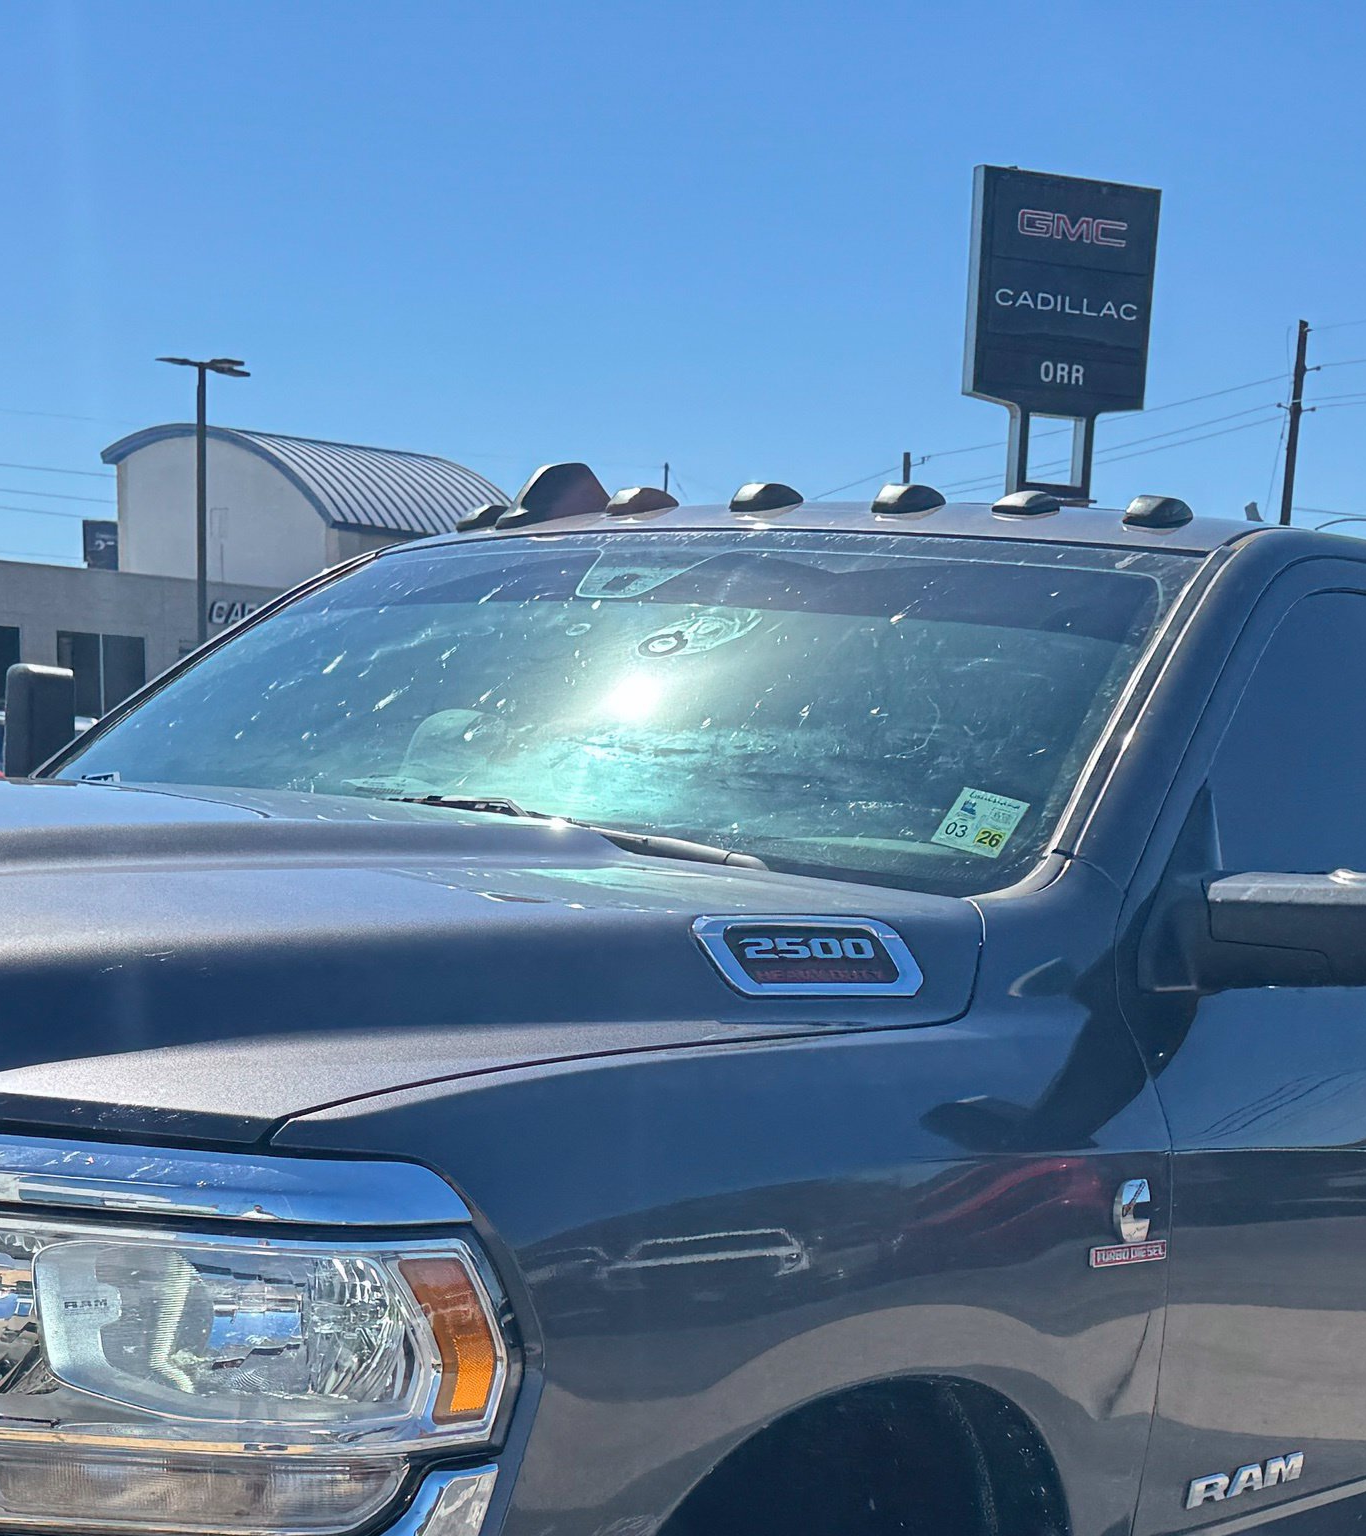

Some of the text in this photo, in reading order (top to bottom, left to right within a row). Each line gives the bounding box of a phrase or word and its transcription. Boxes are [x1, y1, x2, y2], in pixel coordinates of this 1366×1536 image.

[1017, 208, 1128, 248] GMC
[994, 288, 1138, 321] CADILLAC
[1039, 360, 1084, 386] ORR
[944, 821, 1003, 848] 03 26
[738, 937, 875, 959] 2500
[1096, 1244, 1164, 1263] TURBO DIESEL
[1186, 1451, 1305, 1510] RAM
